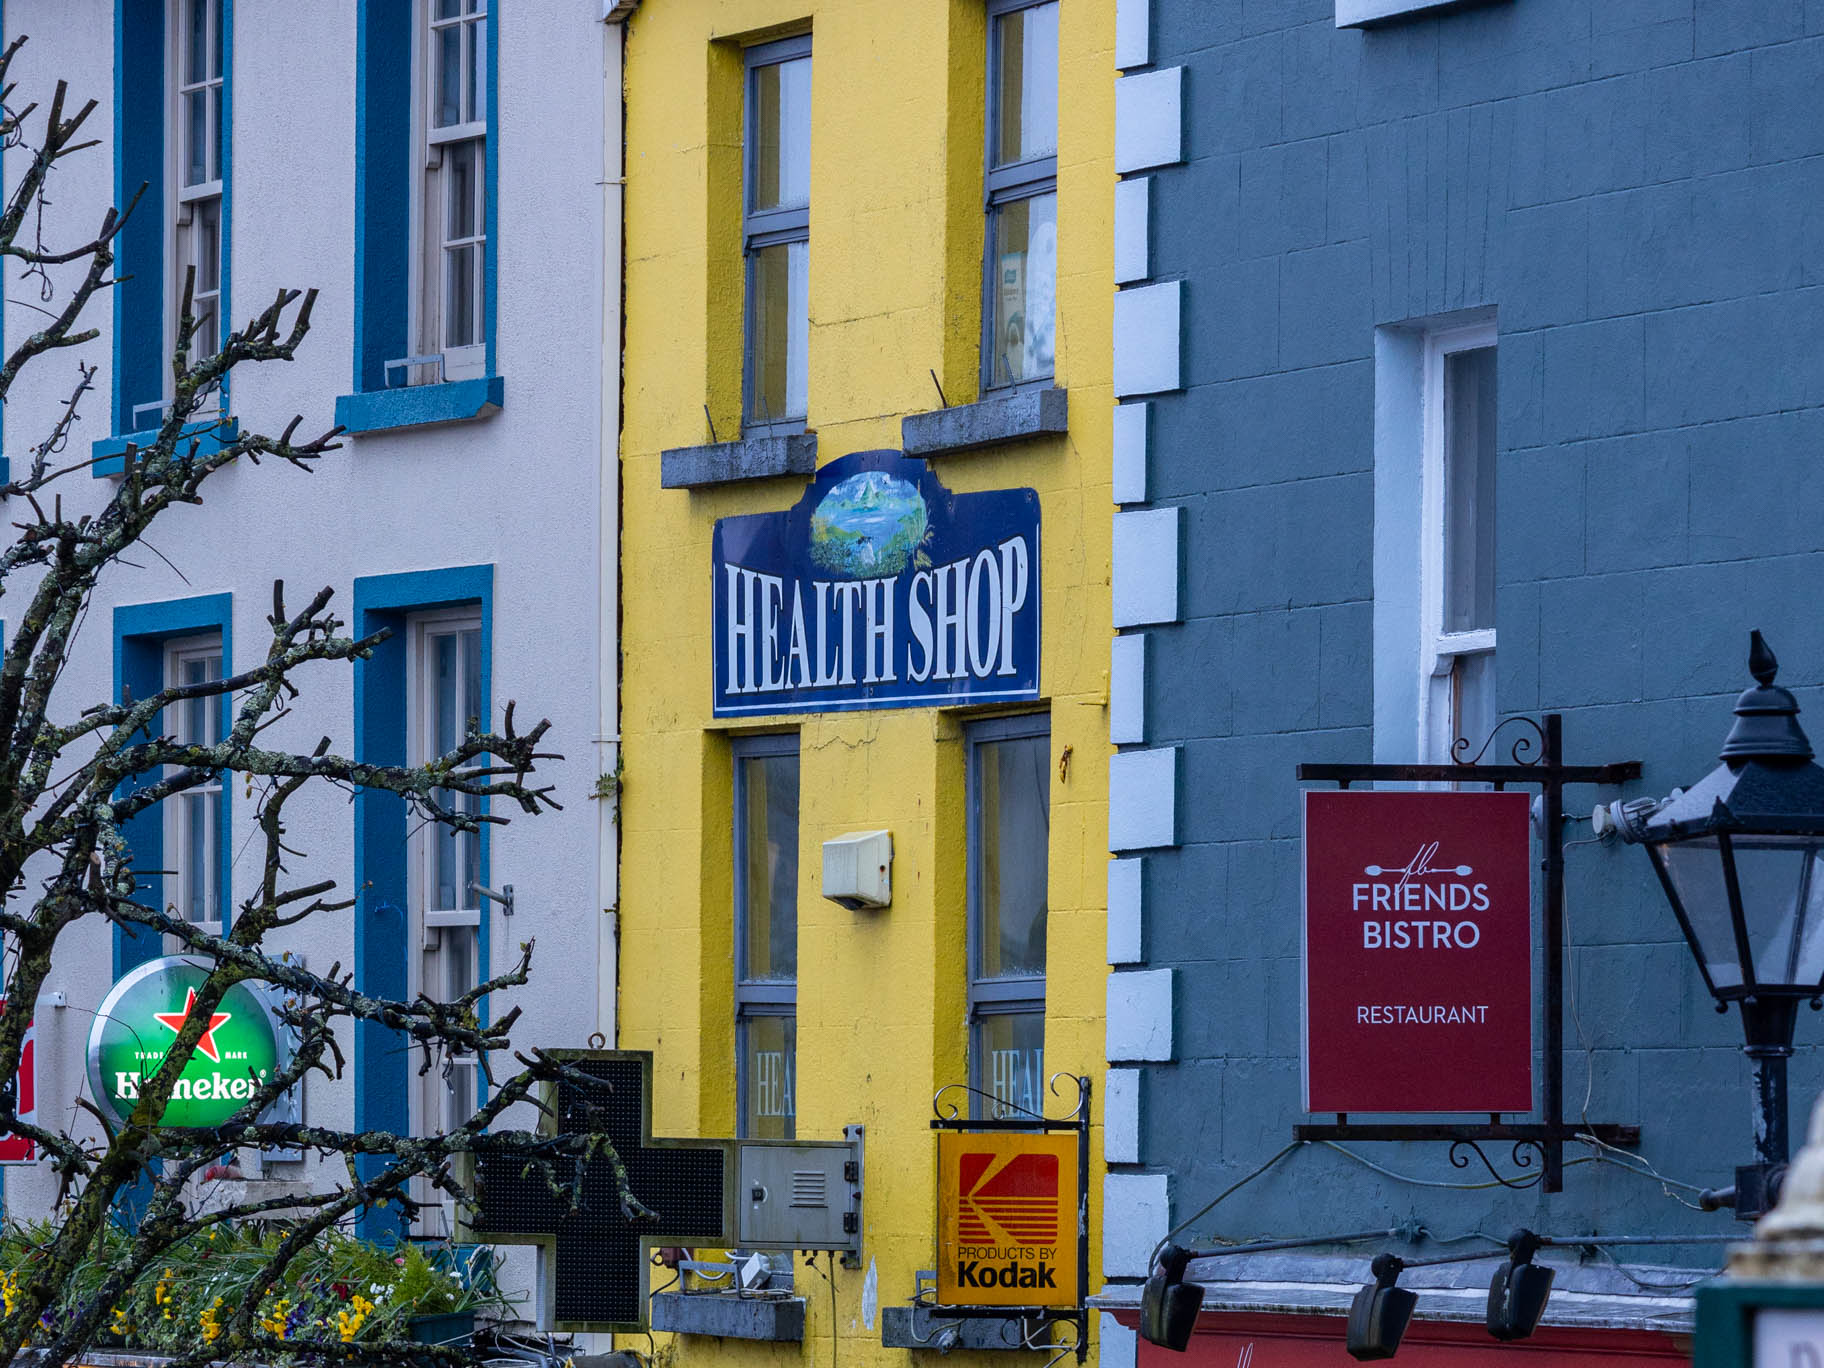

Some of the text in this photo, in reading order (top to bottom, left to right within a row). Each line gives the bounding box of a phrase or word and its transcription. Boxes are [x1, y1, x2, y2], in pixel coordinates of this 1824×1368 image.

[724, 535, 1028, 695] HEALTH SHOP
[1352, 883, 1490, 911] FRIENDS
[1363, 920, 1481, 949] BISTRO
[1357, 1005, 1489, 1025] RESTAURANT
[958, 1246, 1057, 1260] PRODUCTS BY
[957, 1261, 1058, 1289] Kodak
